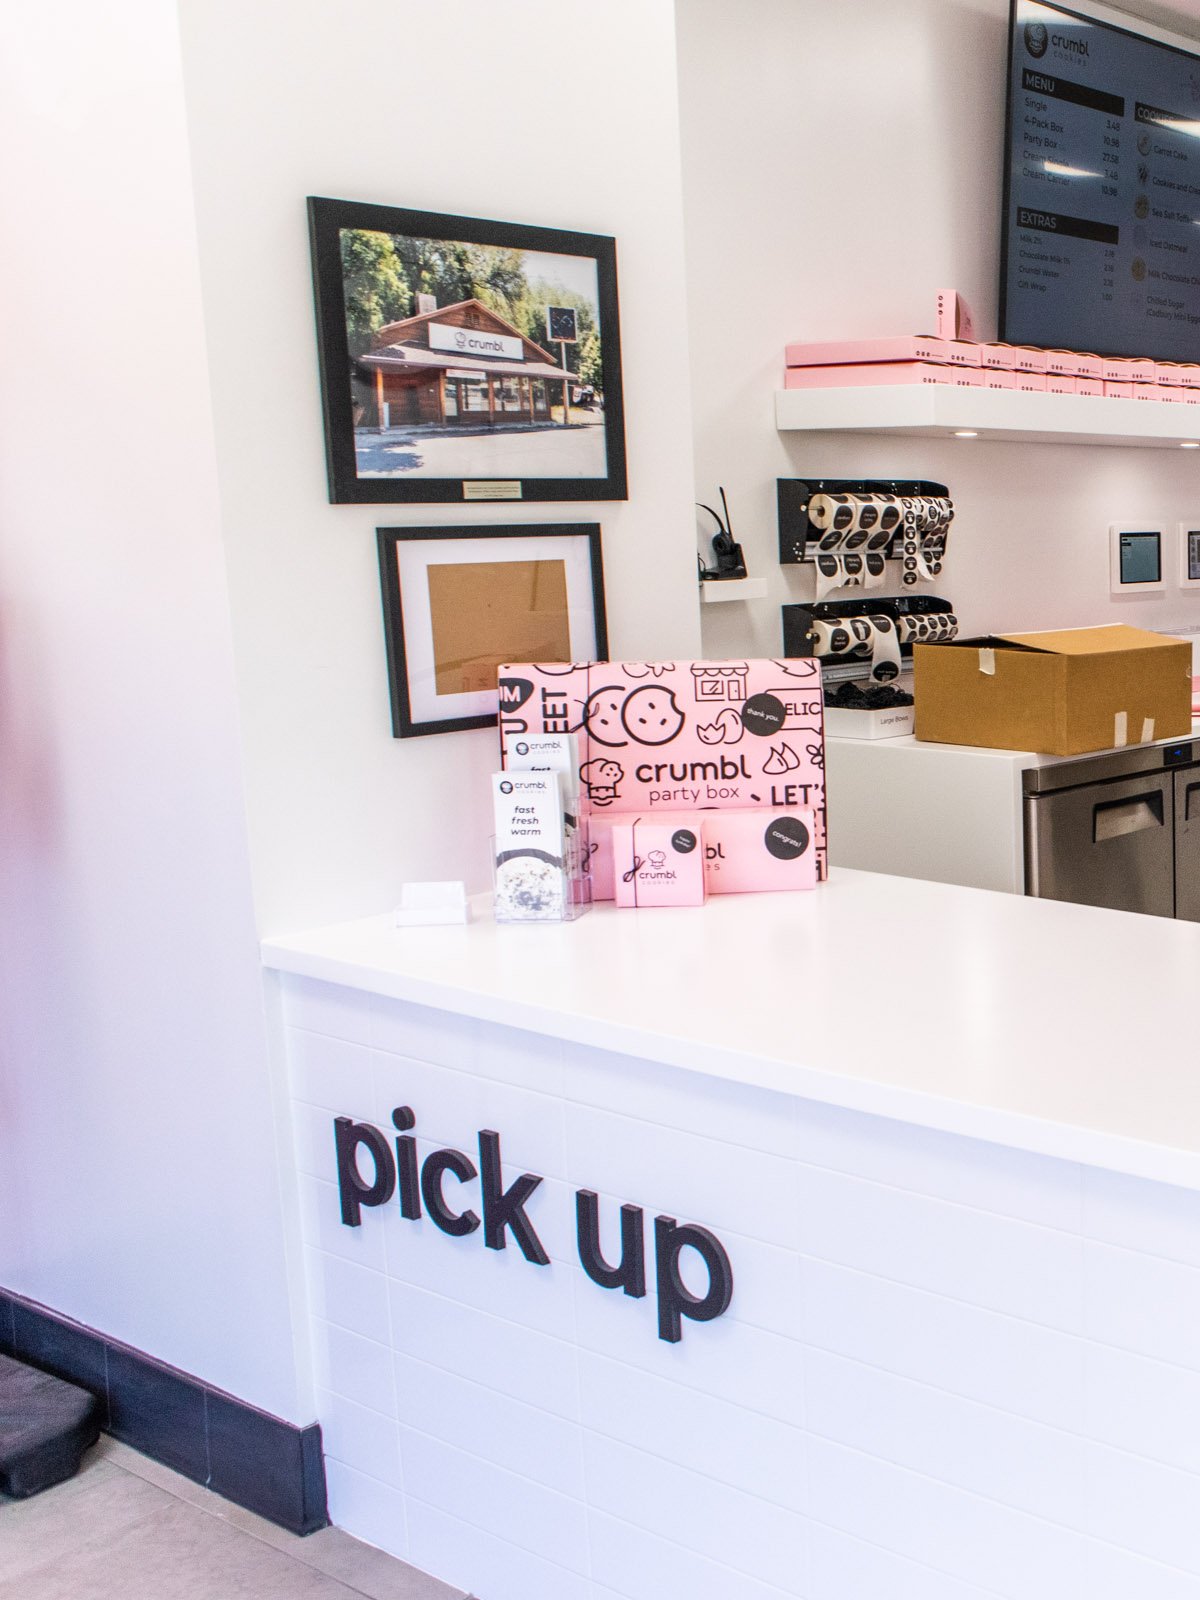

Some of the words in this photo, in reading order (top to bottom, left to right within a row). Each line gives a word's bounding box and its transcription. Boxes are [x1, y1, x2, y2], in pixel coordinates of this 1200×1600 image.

[1051, 34, 1090, 57] crumbl
[1025, 73, 1055, 92] MENU
[1024, 97, 1048, 112] Single
[1024, 115, 1049, 130] 4-Pack
[1050, 121, 1064, 133] Box
[1106, 119, 1120, 132] 3.48
[1024, 132, 1043, 147] Party
[1044, 137, 1058, 149] Box
[1154, 144, 1171, 158] Carrot
[1172, 150, 1188, 161] Cake
[1022, 167, 1046, 180] Cream
[1020, 211, 1057, 229] EXTRAS
[1152, 208, 1162, 218] Sea
[1163, 209, 1175, 221] Salt
[468, 338, 505, 353] crumbl
[746, 707, 765, 718] thank
[530, 741, 562, 749] crumbl
[635, 754, 752, 784] crumbl
[514, 781, 547, 789] crumbl
[649, 787, 700, 806] party
[706, 784, 740, 799] box
[514, 805, 535, 814] fast
[511, 816, 539, 825] fresh
[510, 828, 541, 836] warm
[639, 870, 677, 880] crumbl
[334, 1105, 551, 1266] pick
[575, 1188, 734, 1344] up
